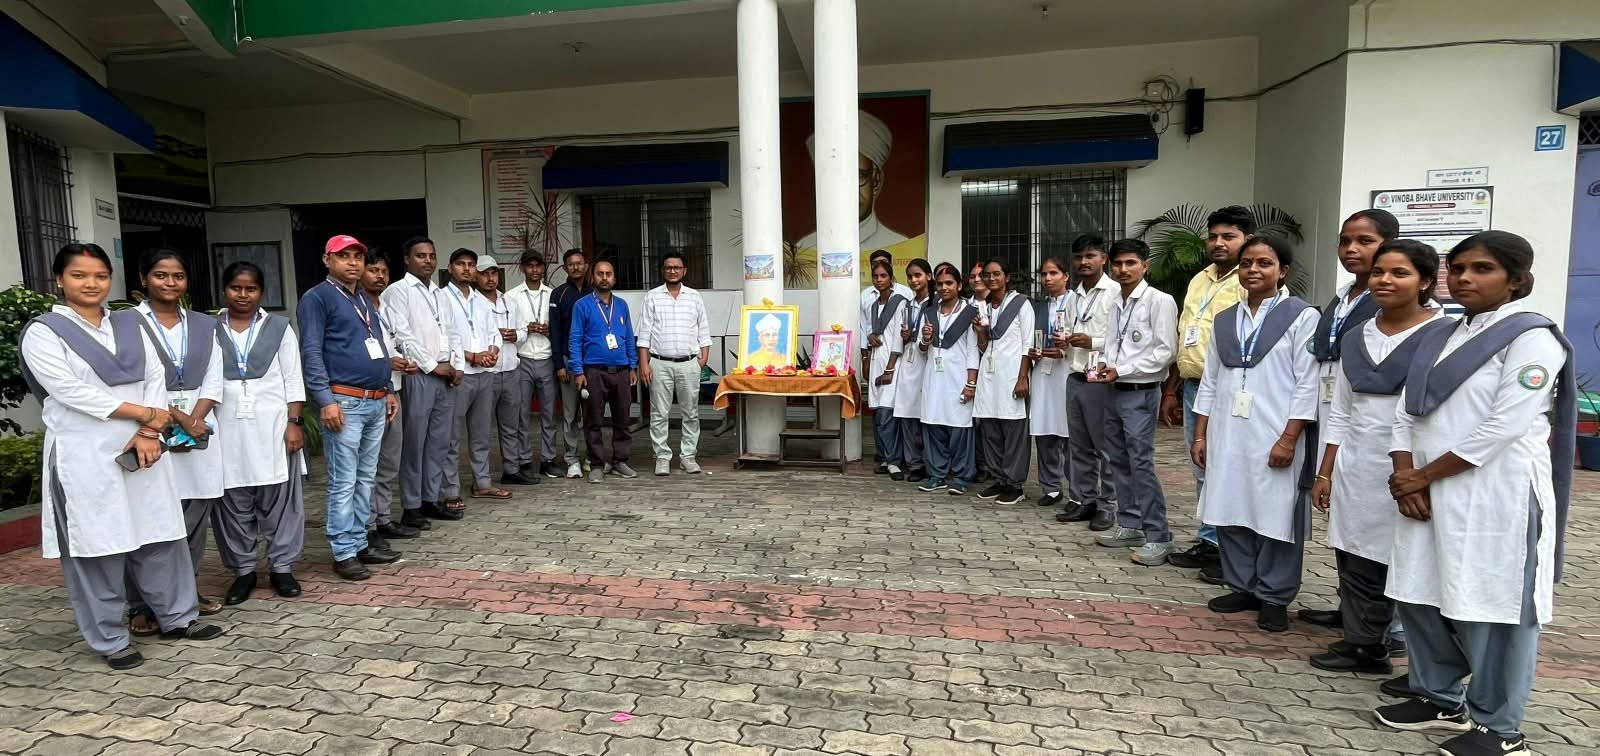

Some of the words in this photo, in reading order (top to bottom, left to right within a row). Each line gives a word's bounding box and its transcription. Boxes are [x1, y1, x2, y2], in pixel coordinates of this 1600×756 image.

[1541, 130, 1561, 145] 27
[1391, 194, 1414, 203] VINOBA
[1415, 193, 1436, 202] BHAVE
[1437, 191, 1475, 201] UNIVERSITY
